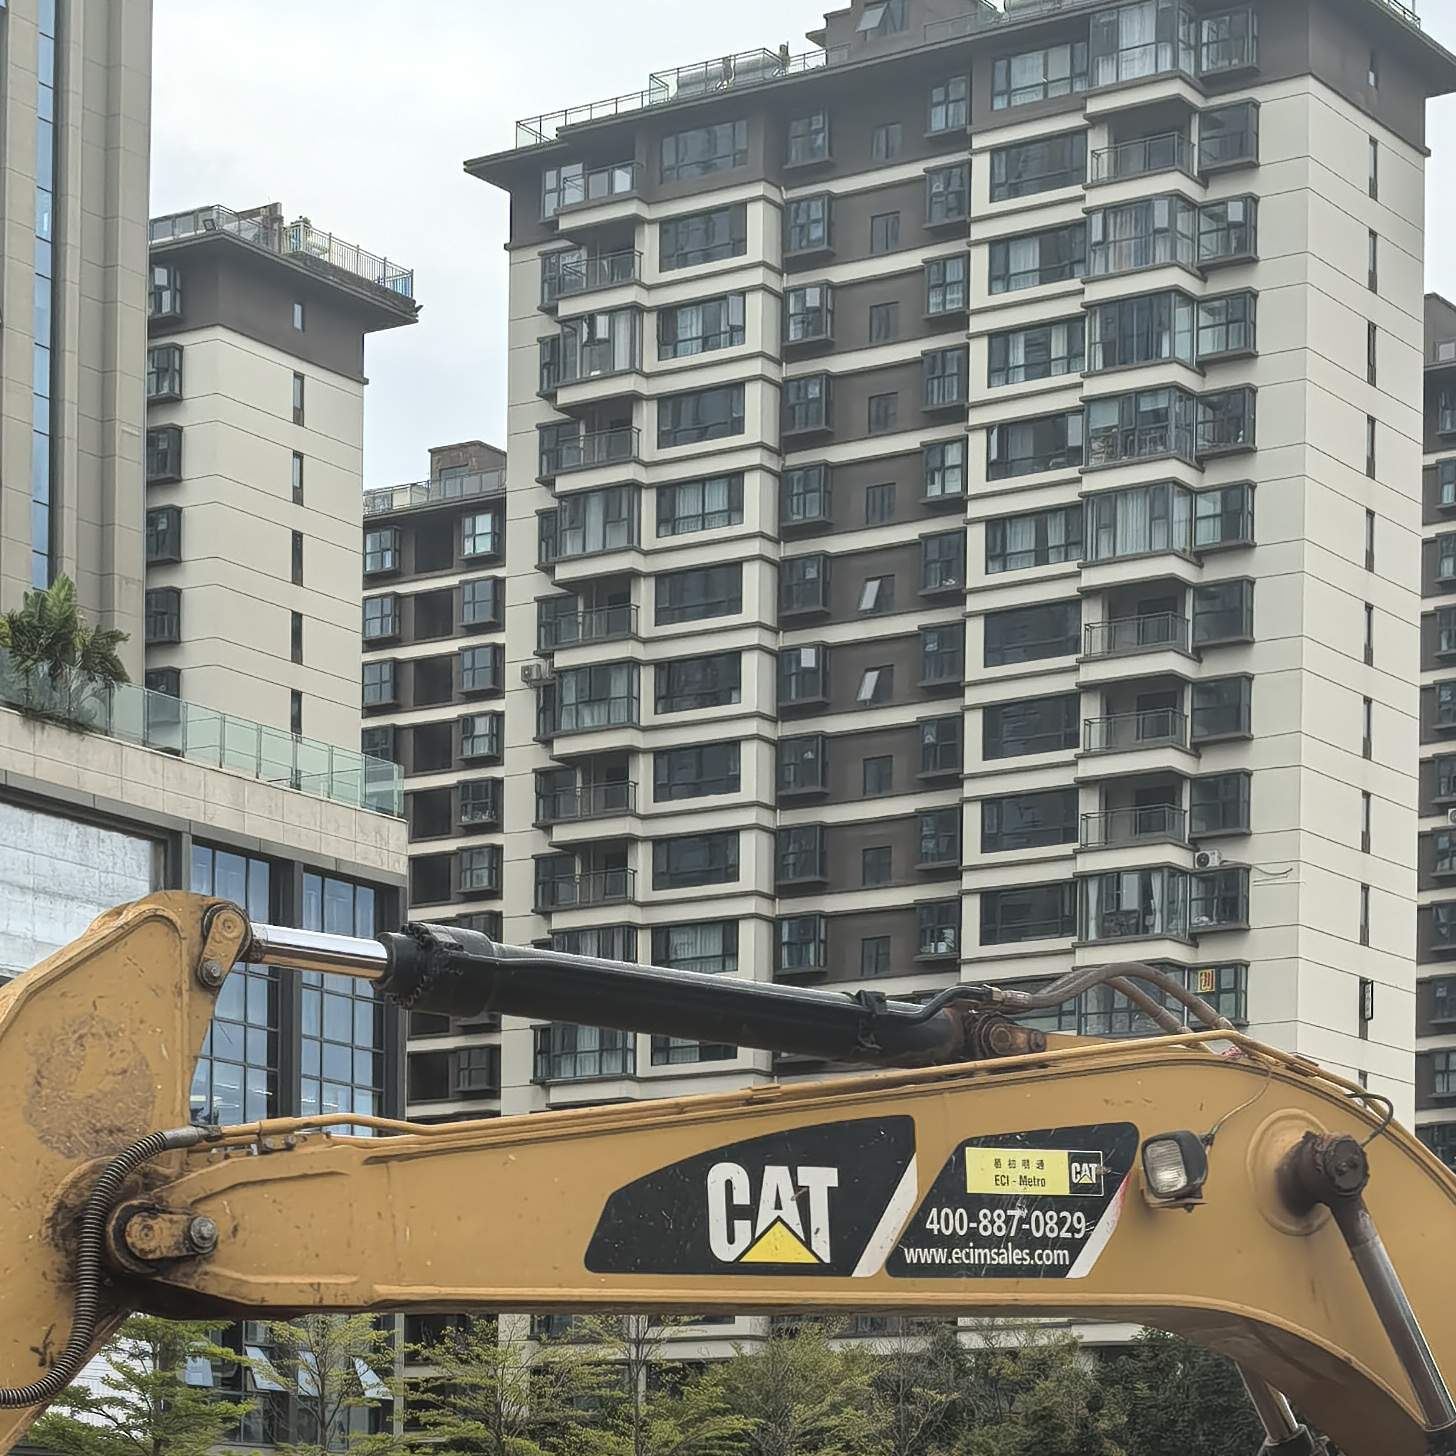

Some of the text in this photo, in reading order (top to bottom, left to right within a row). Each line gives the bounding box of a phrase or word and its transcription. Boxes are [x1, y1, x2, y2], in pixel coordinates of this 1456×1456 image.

[995, 1174, 1009, 1186] ECI
[1019, 1175, 1046, 1187] Metro
[1071, 1162, 1097, 1184] CAT
[707, 1162, 838, 1264] CAT
[926, 1207, 1086, 1238] 400-887-0829
[904, 1242, 1070, 1265] www.ecimsales.com
